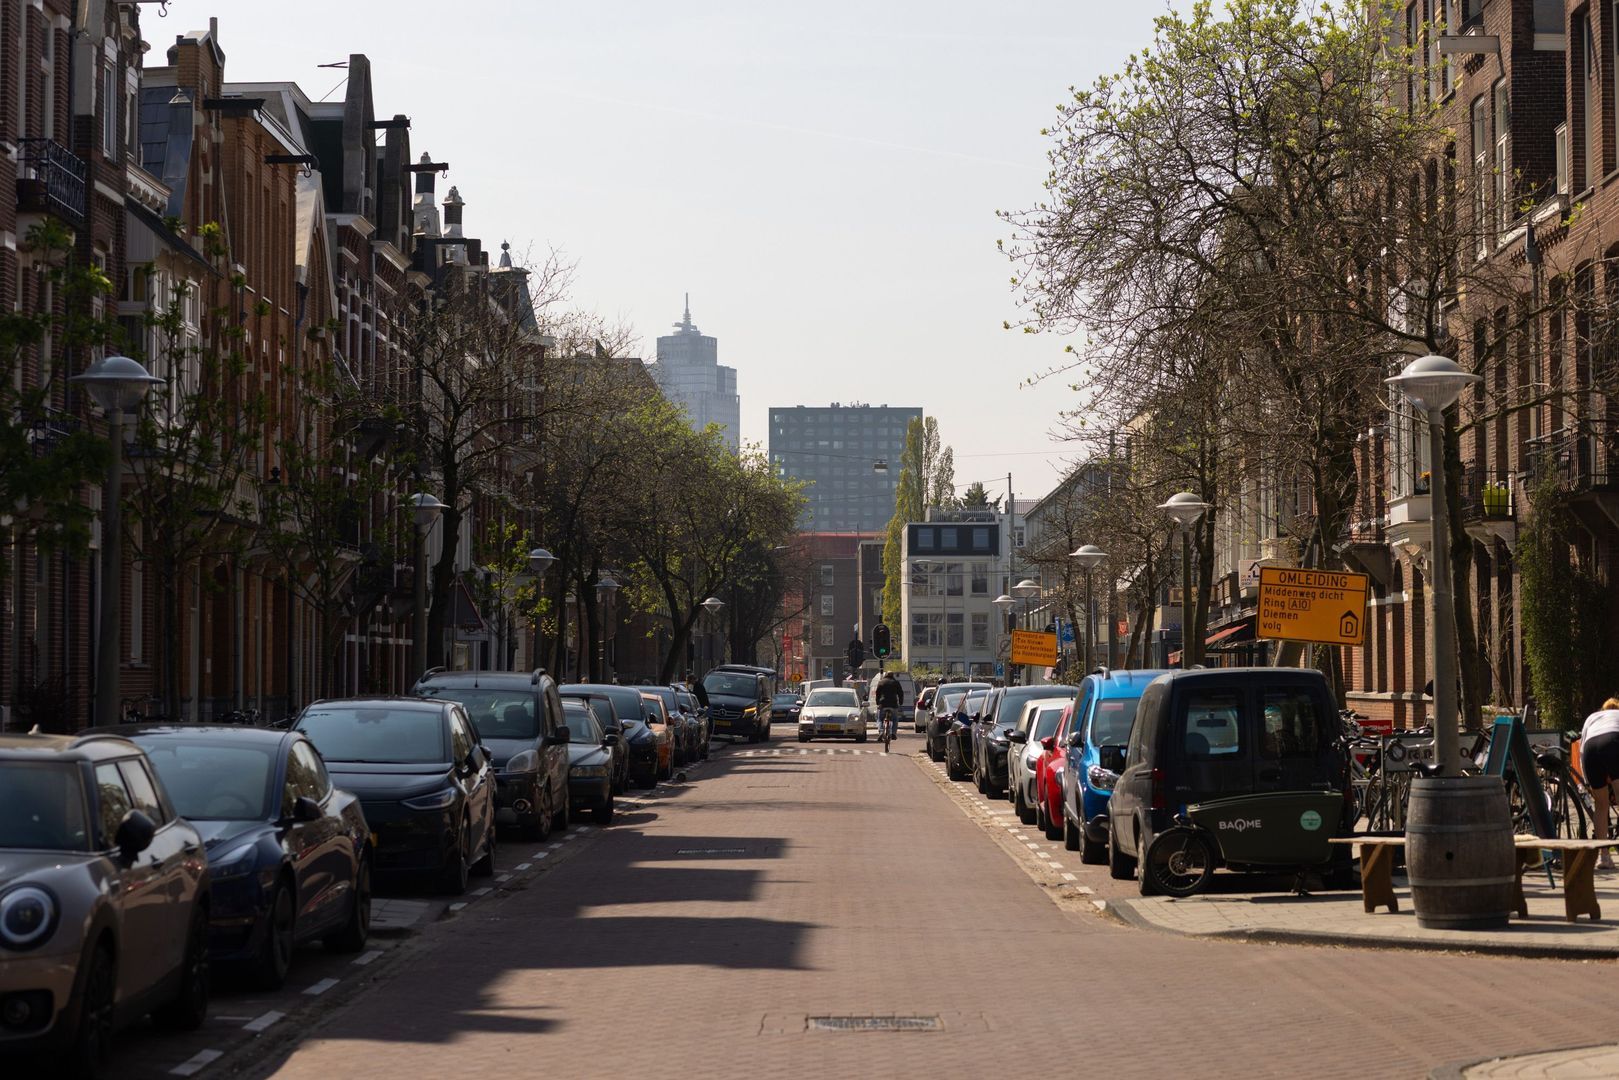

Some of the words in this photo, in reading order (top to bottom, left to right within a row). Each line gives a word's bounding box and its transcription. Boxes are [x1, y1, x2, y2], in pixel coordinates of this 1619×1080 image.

[1279, 572, 1348, 587] OMLEIDING
[1264, 587, 1316, 599] Middenweg
[1319, 590, 1344, 600] dicht
[1264, 598, 1285, 609] Ring
[1291, 600, 1308, 609] A10
[1263, 609, 1298, 620] Diemen
[1263, 621, 1281, 632] volg
[1345, 621, 1354, 634] D
[1218, 818, 1262, 832] BAQME
